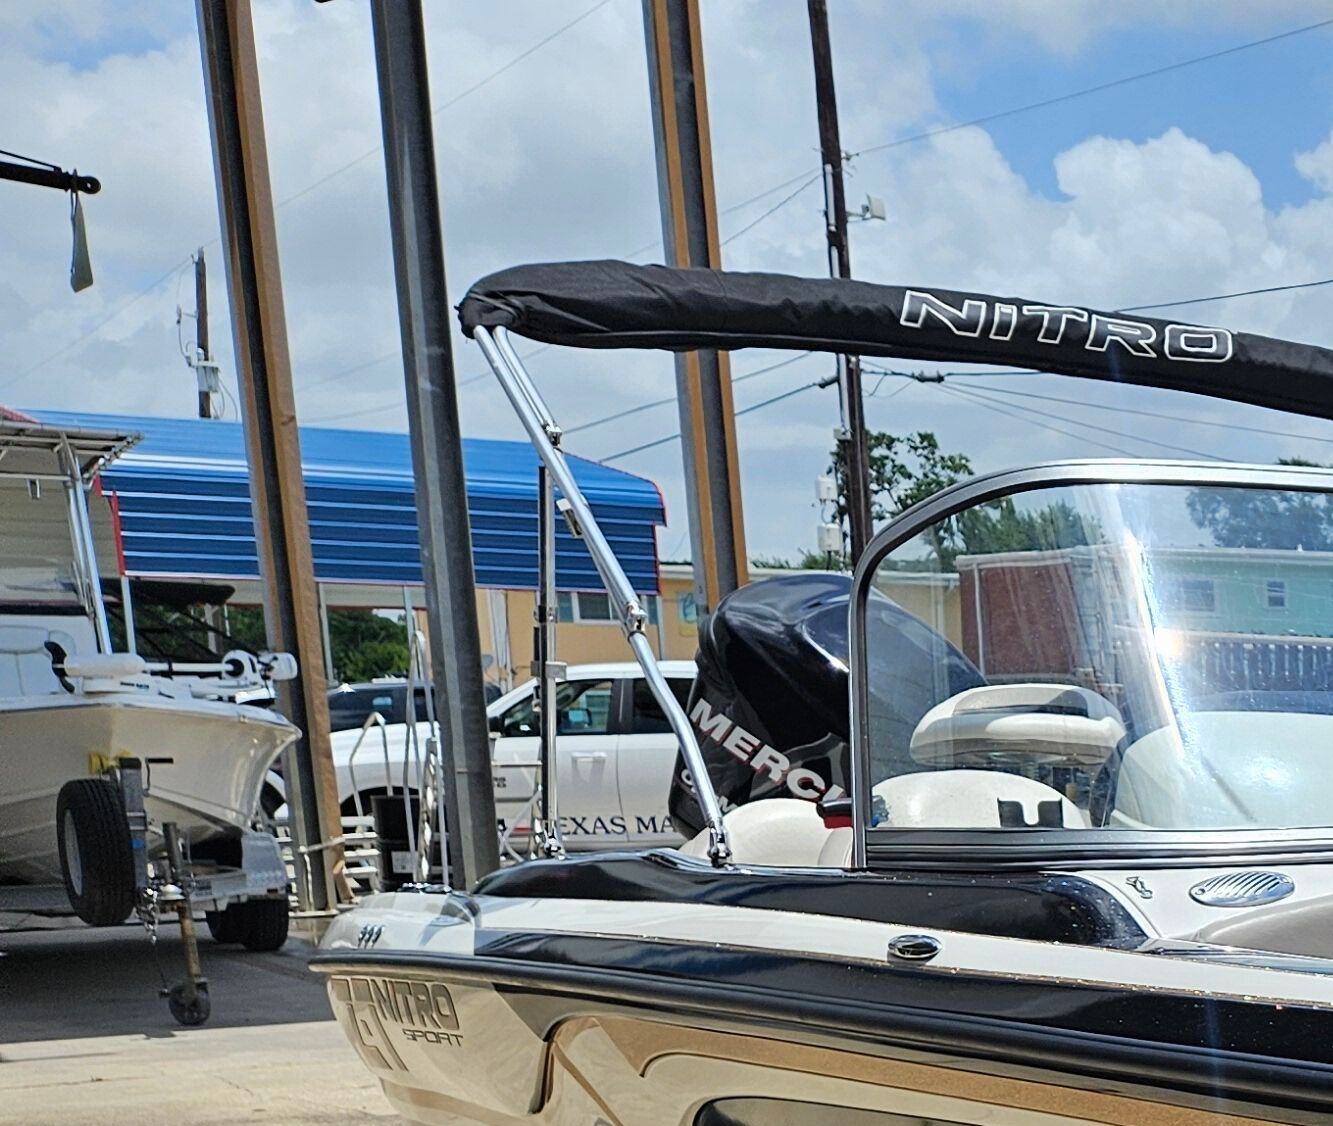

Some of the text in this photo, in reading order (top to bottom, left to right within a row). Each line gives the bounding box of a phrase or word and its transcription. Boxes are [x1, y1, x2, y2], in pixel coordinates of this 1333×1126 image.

[900, 290, 1233, 363] NITRO
[559, 816, 627, 835] EXAS
[370, 978, 460, 1031] NITRO
[402, 1029, 463, 1047] SPORT
